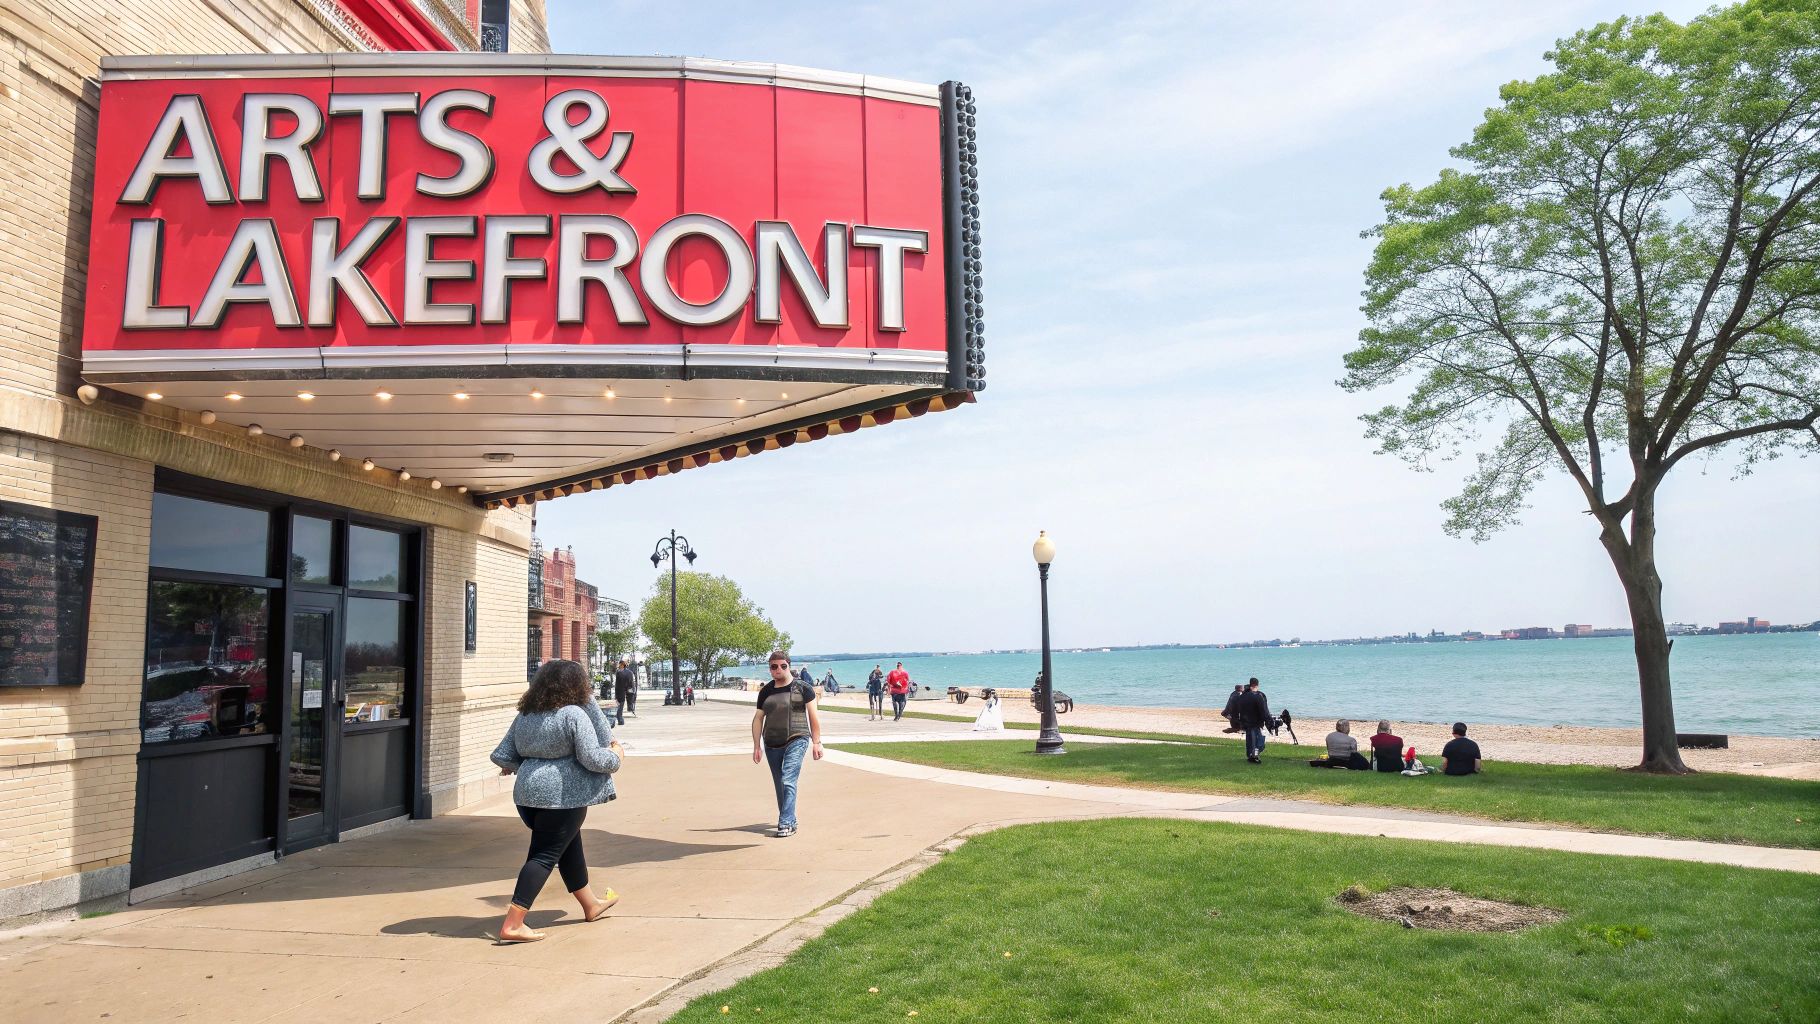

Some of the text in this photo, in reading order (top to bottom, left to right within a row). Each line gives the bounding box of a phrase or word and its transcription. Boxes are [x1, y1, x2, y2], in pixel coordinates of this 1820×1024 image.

[118, 89, 637, 203] ARTS &
[122, 214, 929, 331] LAKEFRONT
